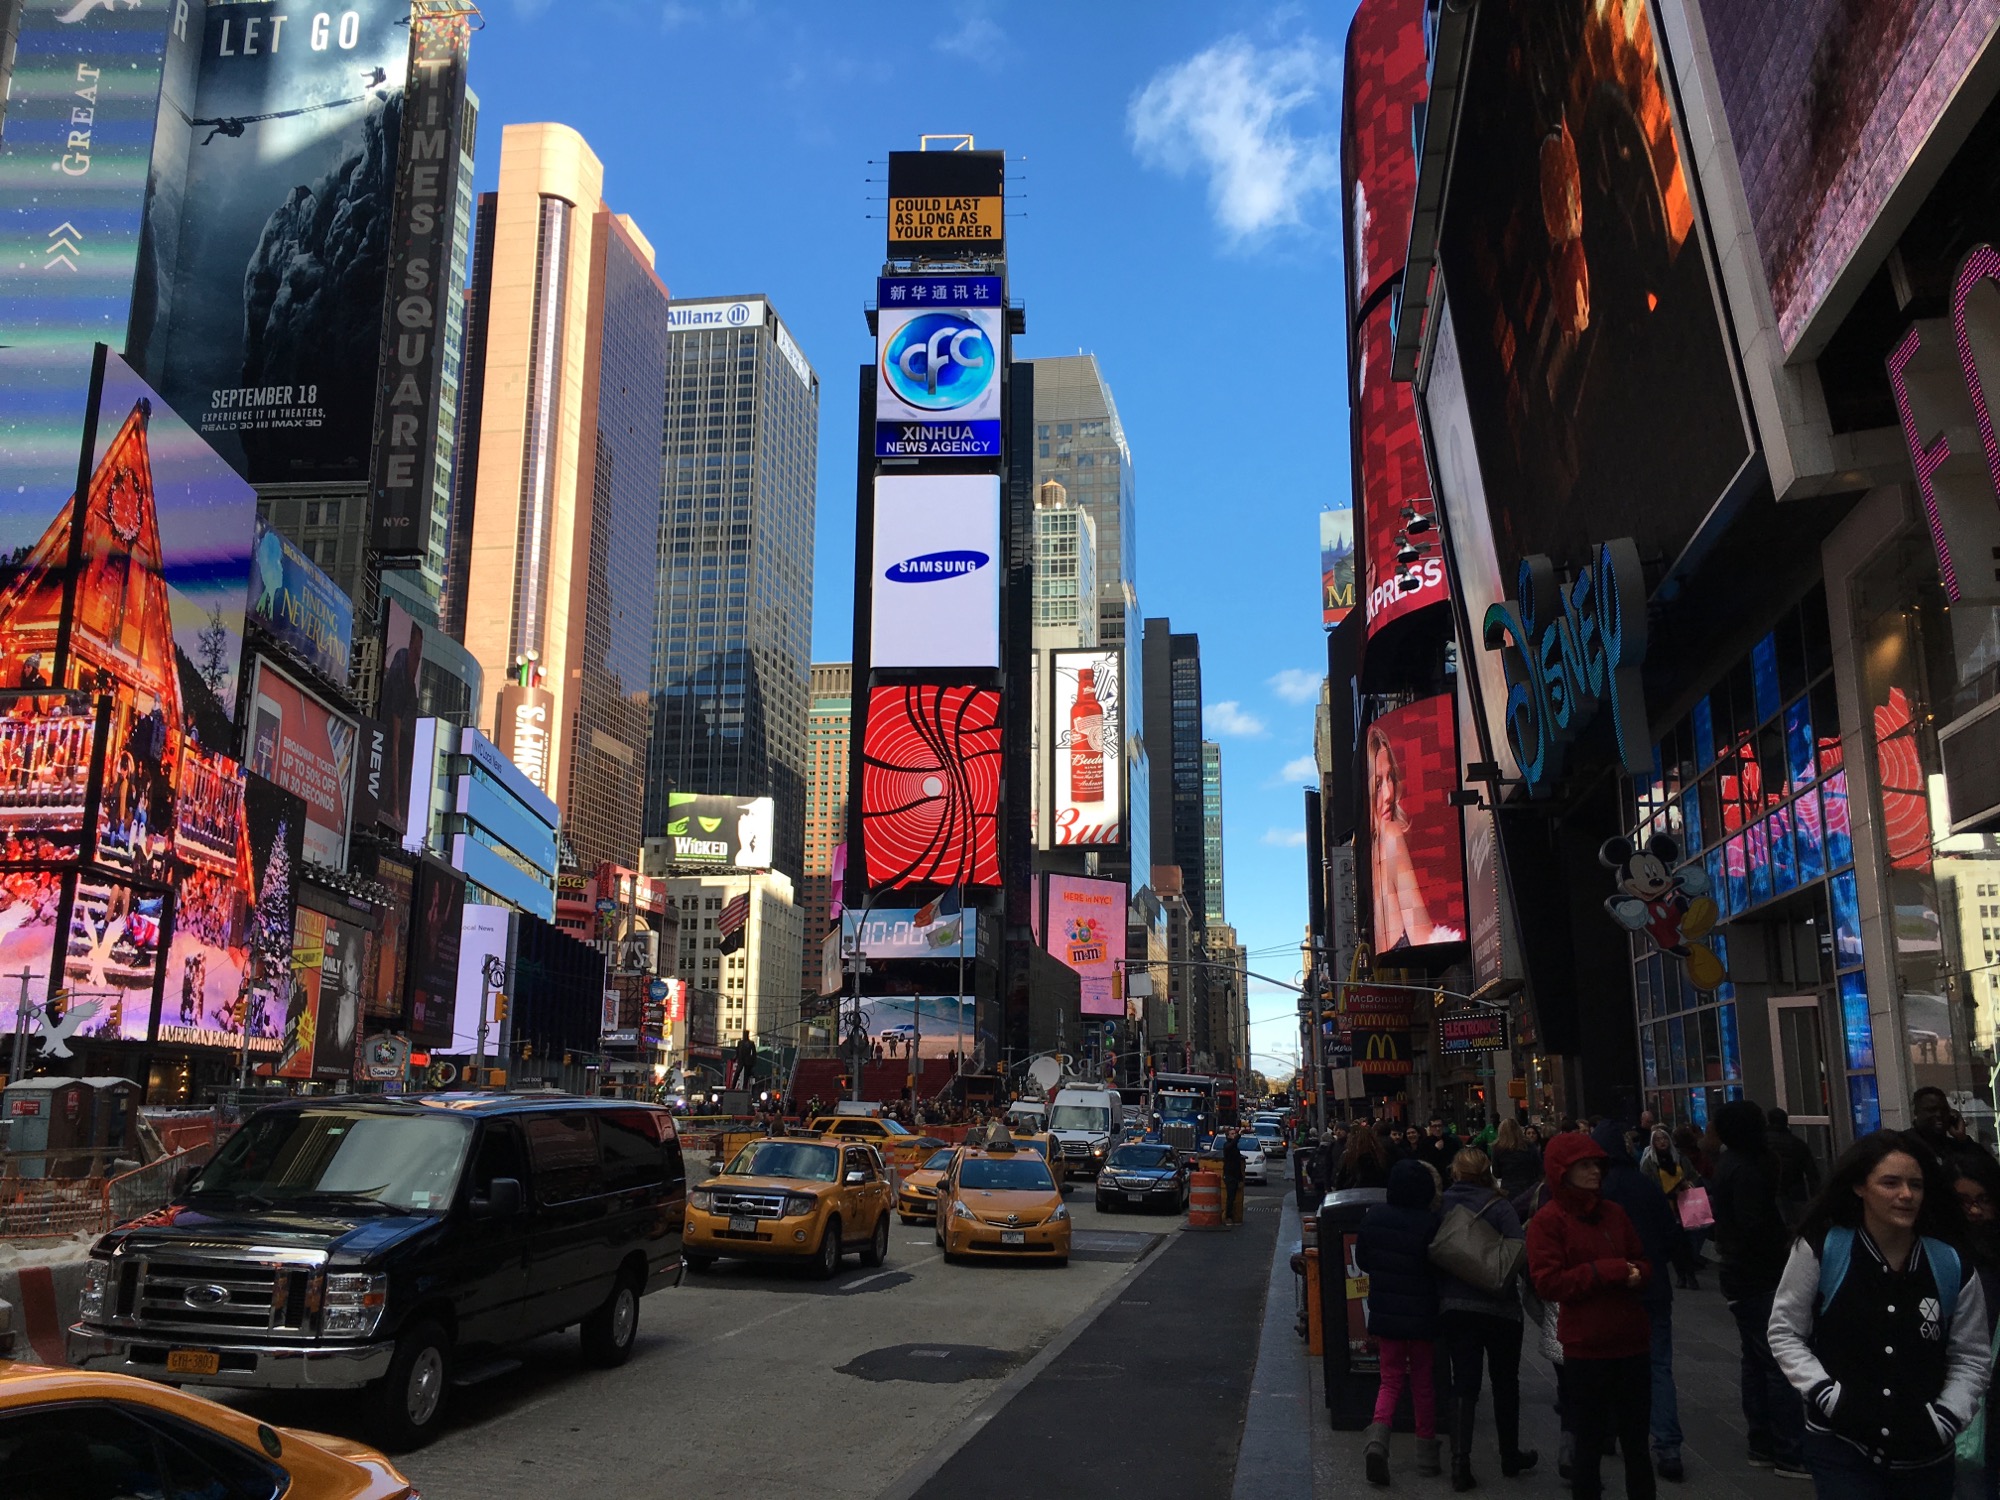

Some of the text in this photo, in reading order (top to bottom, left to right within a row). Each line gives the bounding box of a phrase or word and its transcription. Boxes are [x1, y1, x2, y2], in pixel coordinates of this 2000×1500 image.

[219, 11, 360, 57] LET GO
[61, 62, 100, 176] GREAT
[895, 198, 980, 212] COULD LAST
[895, 212, 979, 226] AS LONG AS
[894, 225, 993, 240] YOUR CAREER
[387, 59, 450, 488] TIMES SQUARE
[890, 283, 990, 301] 新华通讯社
[668, 309, 723, 326] Allianz
[210, 384, 318, 409] SEPTEMBER 18
[201, 407, 326, 422] EXPERIENCE IT IN THEATERS,
[239, 422, 254, 430] 3D
[255, 421, 270, 429] AND
[305, 419, 323, 427] 3D
[902, 426, 975, 441] XINHUA
[886, 440, 991, 453] NEWS AGENCY
[382, 516, 410, 528] NYC
[899, 559, 977, 574] SAMSUNG
[303, 585, 338, 632] FINDING
[280, 587, 348, 668] NEVERLAND
[1483, 542, 1630, 797] Disney
[284, 736, 337, 778] BROADWAY TICKETS
[367, 730, 384, 800] NEW
[282, 751, 336, 795] UP TO 50% OFF
[281, 769, 335, 812] IN 30 SECONDS
[1063, 892, 1084, 902] HERE
[1094, 895, 1112, 905] NYC!
[325, 929, 339, 946] ONE
[323, 955, 341, 974] ONLY
[1444, 1018, 1499, 1036] ELECTRONICS
[1445, 1036, 1500, 1049] CAMERA LUGGAGE
[372, 1068, 396, 1076] Sanrio
[1920, 1322, 1941, 1341] EXO
